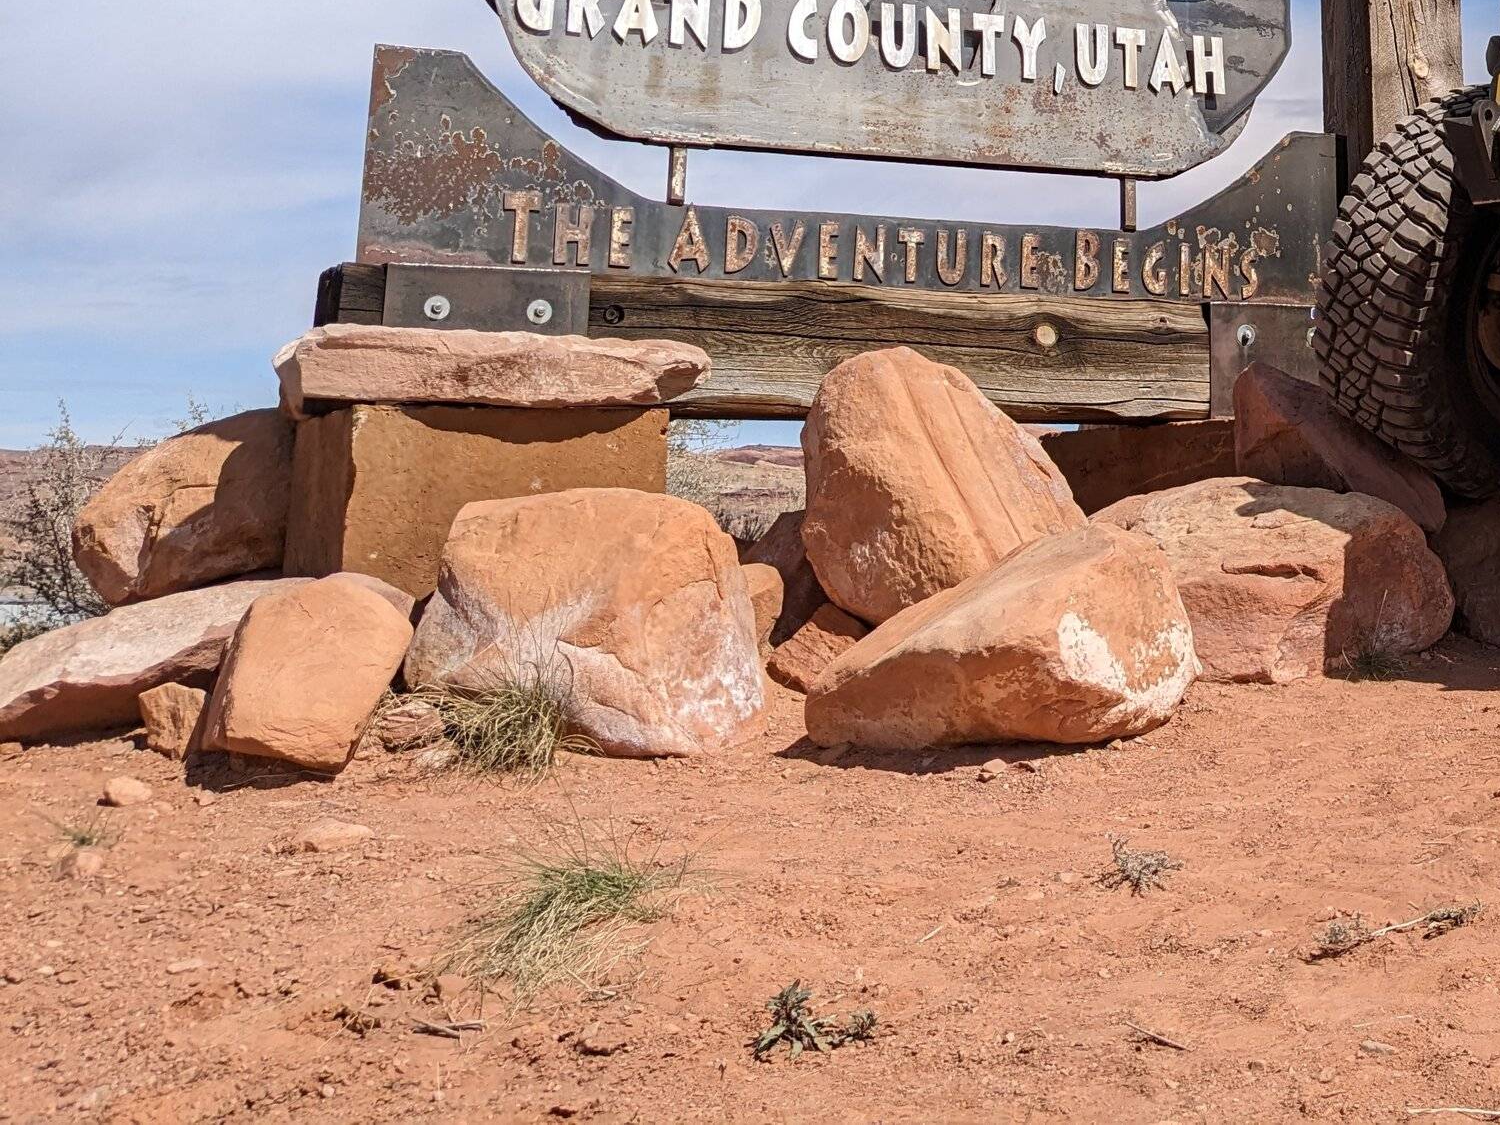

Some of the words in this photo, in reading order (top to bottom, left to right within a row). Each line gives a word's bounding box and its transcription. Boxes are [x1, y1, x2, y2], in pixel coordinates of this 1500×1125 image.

[501, 190, 636, 268] THE
[665, 203, 1043, 291] ADVENTURE
[1074, 226, 1261, 300] BEGINS
